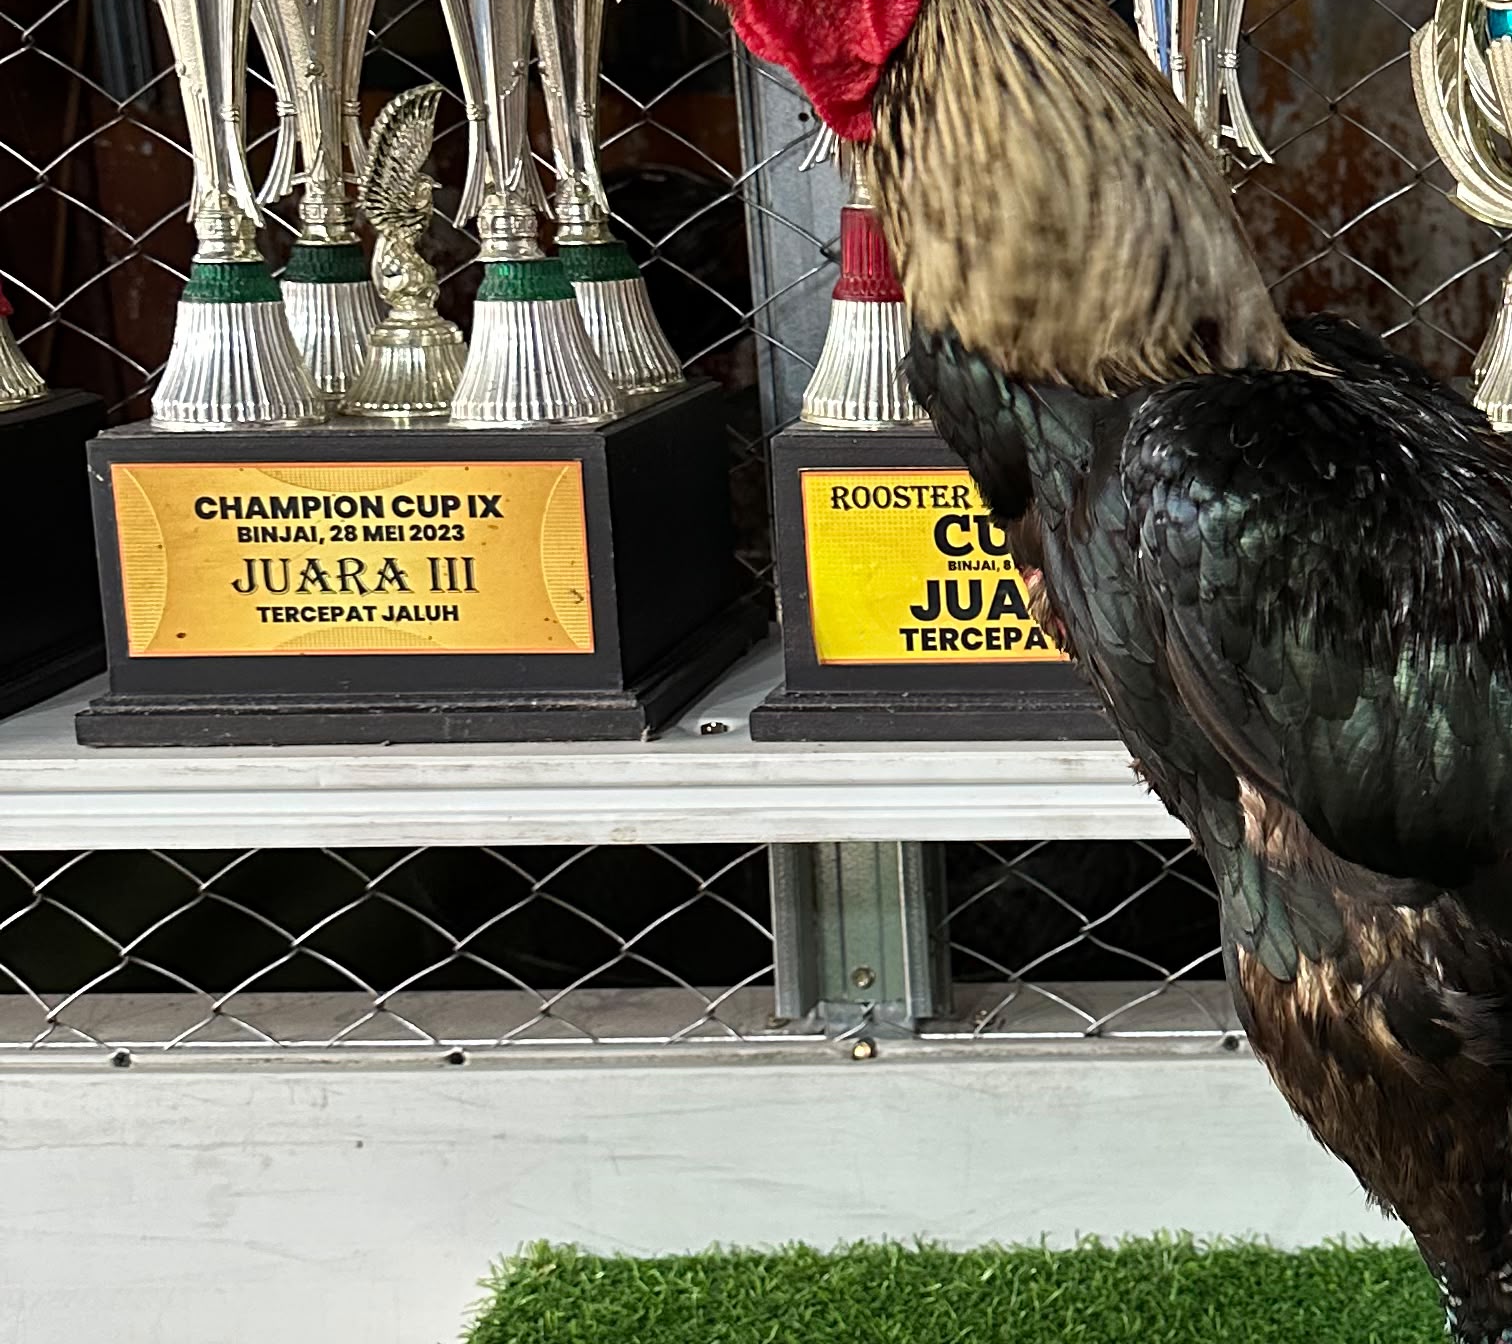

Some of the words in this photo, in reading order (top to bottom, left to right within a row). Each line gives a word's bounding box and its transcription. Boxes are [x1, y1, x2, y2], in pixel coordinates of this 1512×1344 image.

[195, 495, 385, 520] CHAMPION
[392, 495, 461, 519] CUP
[468, 494, 504, 518] IX
[831, 485, 974, 511] ROOSTER
[237, 525, 325, 545] BINJAI,
[330, 525, 358, 542] 28
[363, 525, 405, 542] MEI
[410, 524, 465, 542] 2023
[934, 514, 1010, 557] CU
[231, 556, 415, 596] JUARA
[427, 556, 480, 595] III
[948, 560, 1000, 572] BINJAI,
[909, 579, 1031, 622] JUA
[256, 605, 378, 624] TERCEPAT
[382, 604, 460, 623] JALUH
[900, 627, 1049, 651] TERCEPA
